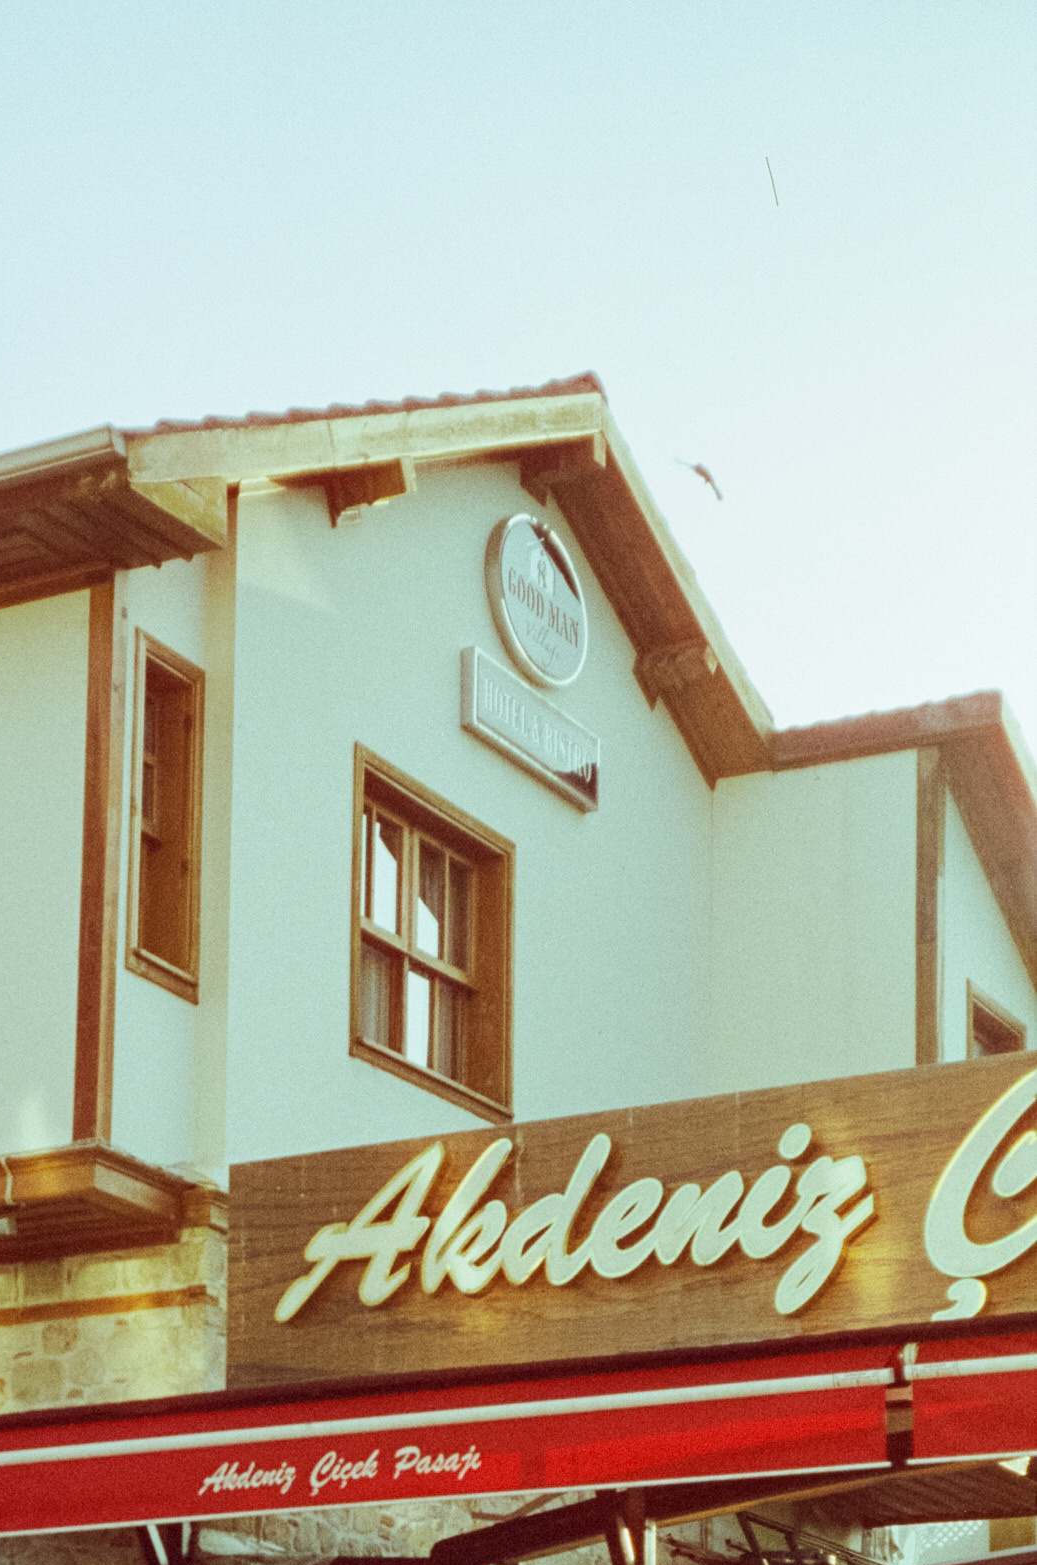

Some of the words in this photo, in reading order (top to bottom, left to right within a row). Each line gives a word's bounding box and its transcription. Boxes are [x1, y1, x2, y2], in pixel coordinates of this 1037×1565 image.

[508, 566, 545, 620] GOOD
[548, 600, 579, 649] MAN
[483, 678, 528, 736] HOTEL
[544, 721, 592, 783] BISTRO
[274, 1122, 876, 1324] Akdeniz
[198, 1461, 297, 1496] Akdeniz
[310, 1450, 380, 1496] Çiçek
